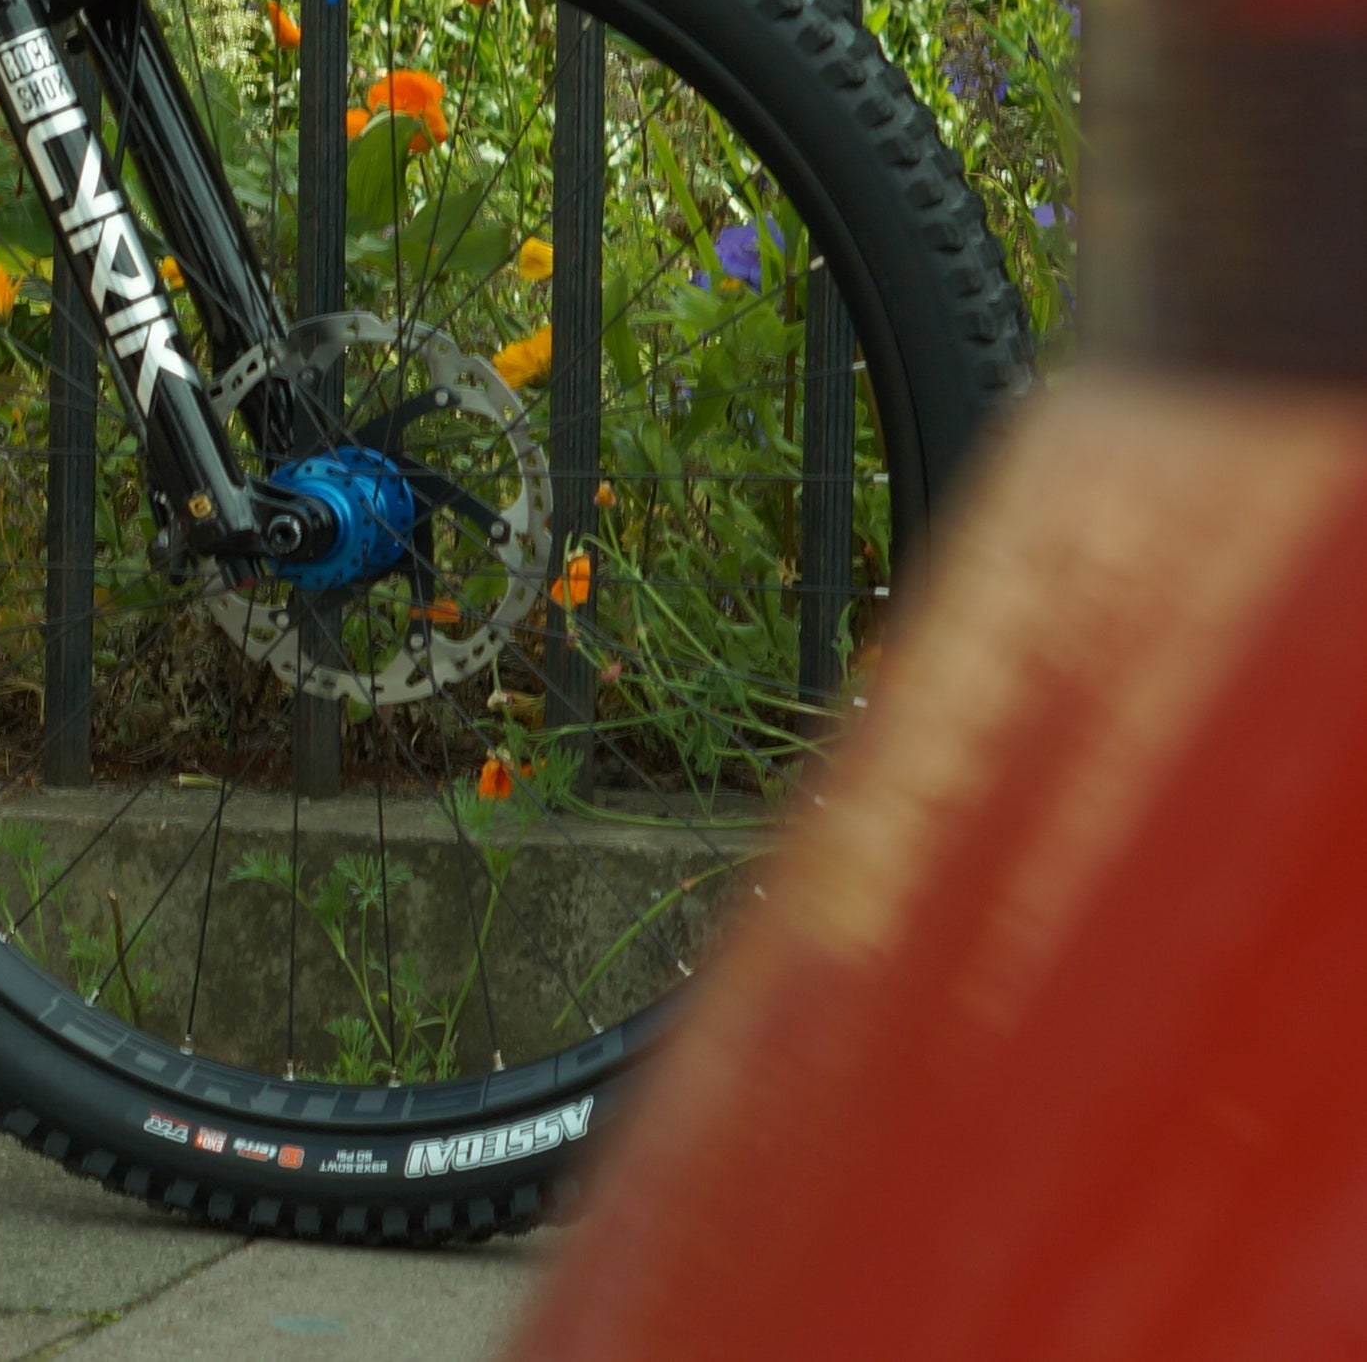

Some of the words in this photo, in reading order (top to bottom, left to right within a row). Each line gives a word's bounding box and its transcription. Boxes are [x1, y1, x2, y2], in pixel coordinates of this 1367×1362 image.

[1, 35, 57, 83] ROCK
[17, 69, 70, 113] SHOX
[27, 106, 202, 419] LYRIK
[404, 1095, 594, 1179] ASSEGAI
